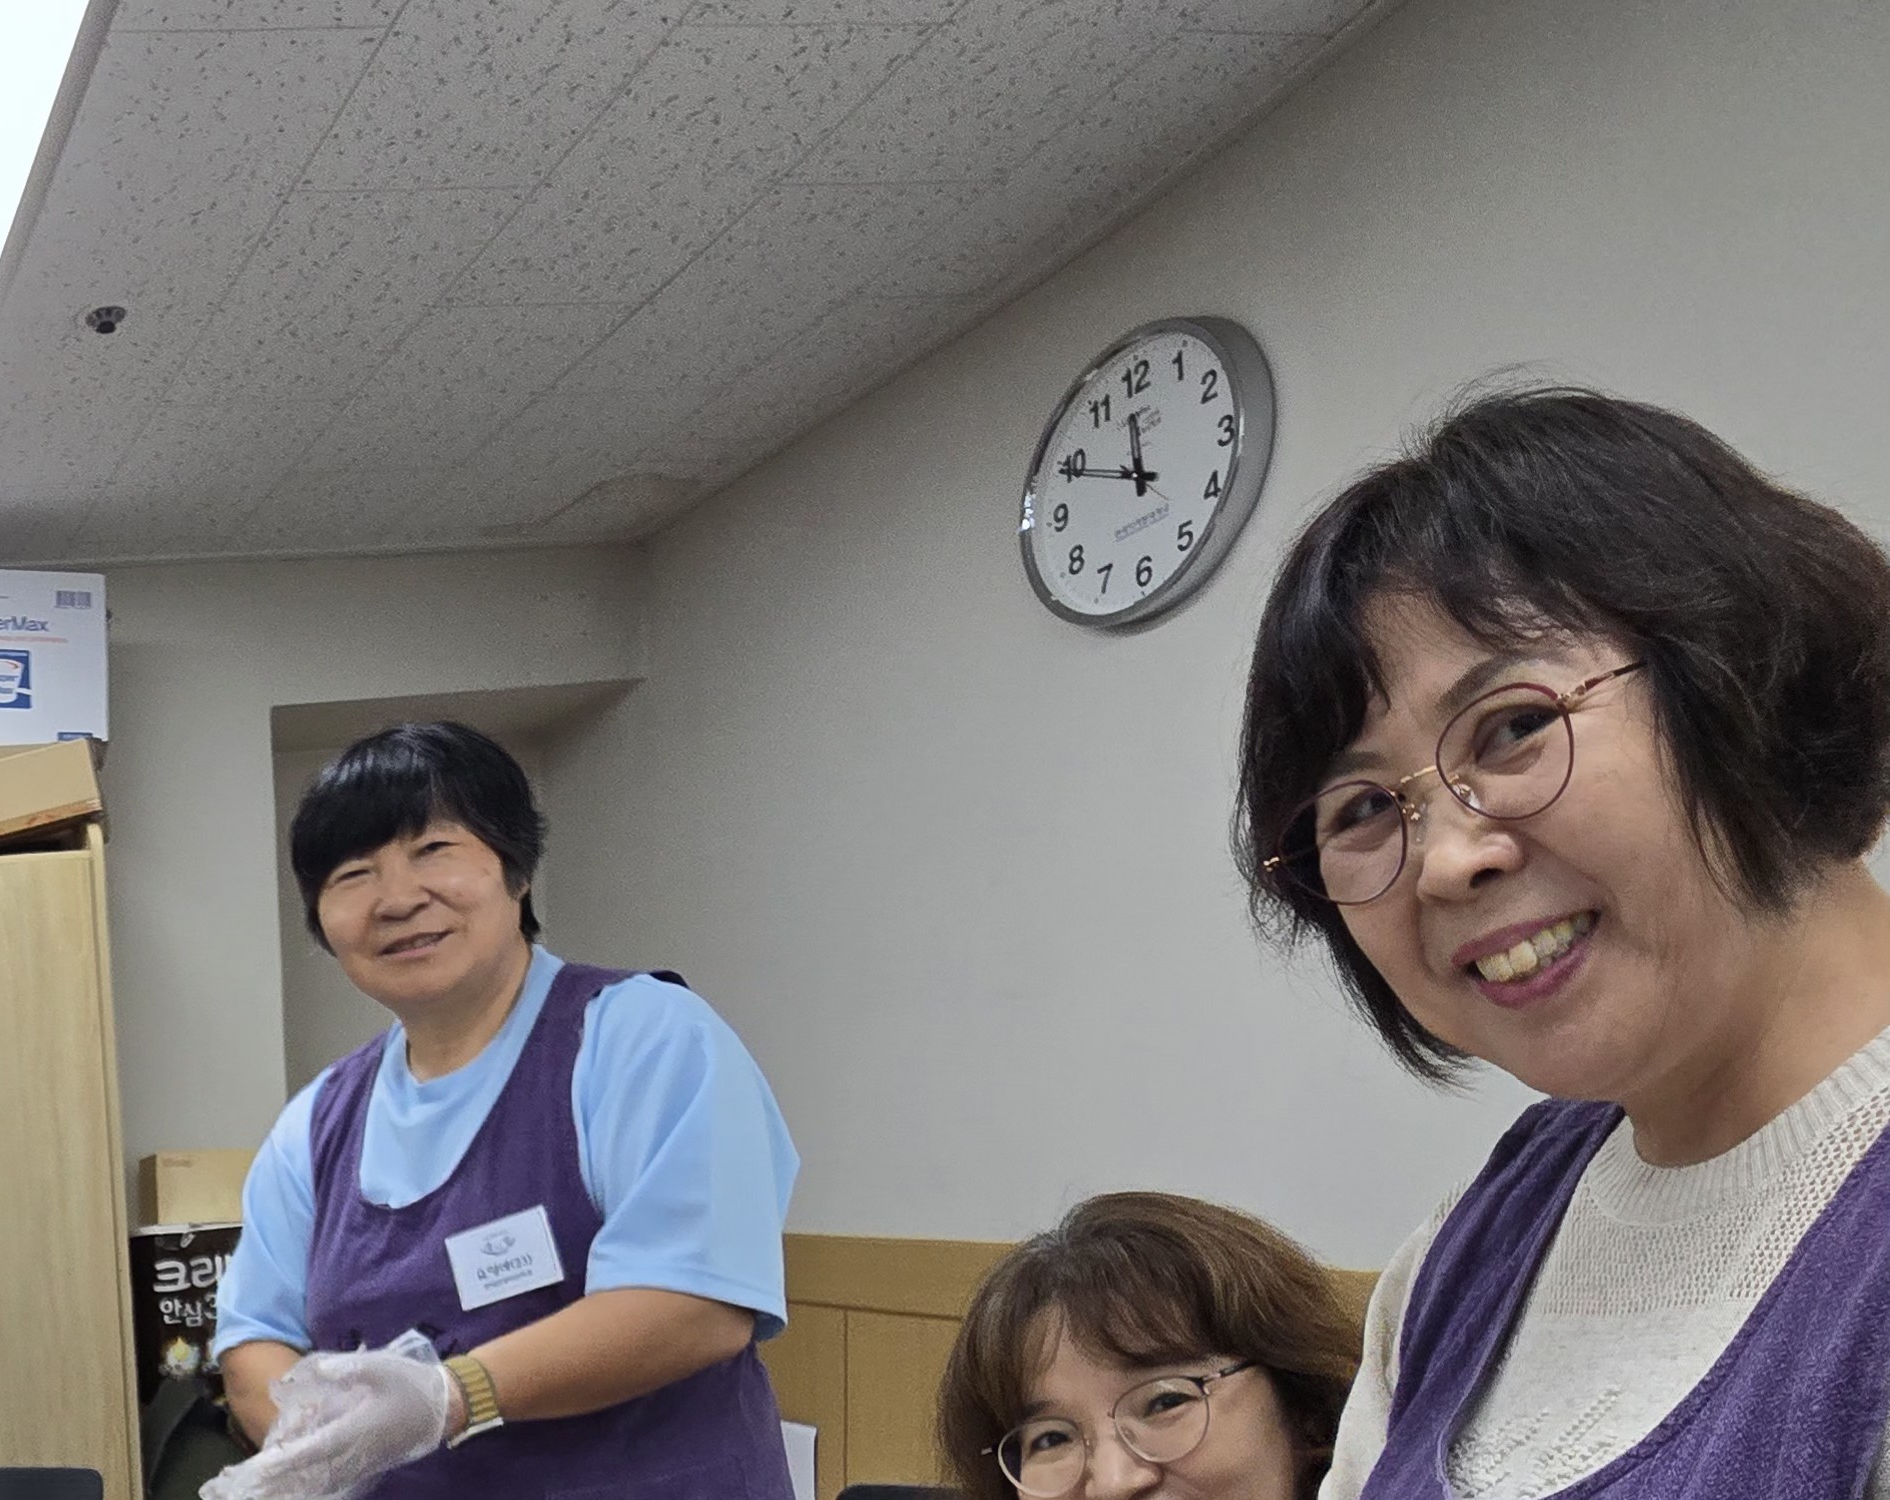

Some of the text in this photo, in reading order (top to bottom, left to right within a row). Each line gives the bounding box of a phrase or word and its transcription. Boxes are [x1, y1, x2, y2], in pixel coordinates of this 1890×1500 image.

[1121, 359, 1151, 399] 12
[1172, 350, 1184, 382] 1
[1200, 369, 1218, 405] 2
[1088, 394, 1111, 428] 11
[1217, 414, 1235, 447] 3
[1059, 448, 1086, 483] 10
[1203, 470, 1221, 500] 4
[1053, 503, 1069, 532] 9
[1177, 520, 1194, 552] 5
[1068, 544, 1085, 575] 8
[1135, 555, 1152, 587] 6
[1097, 563, 1113, 594] 7
